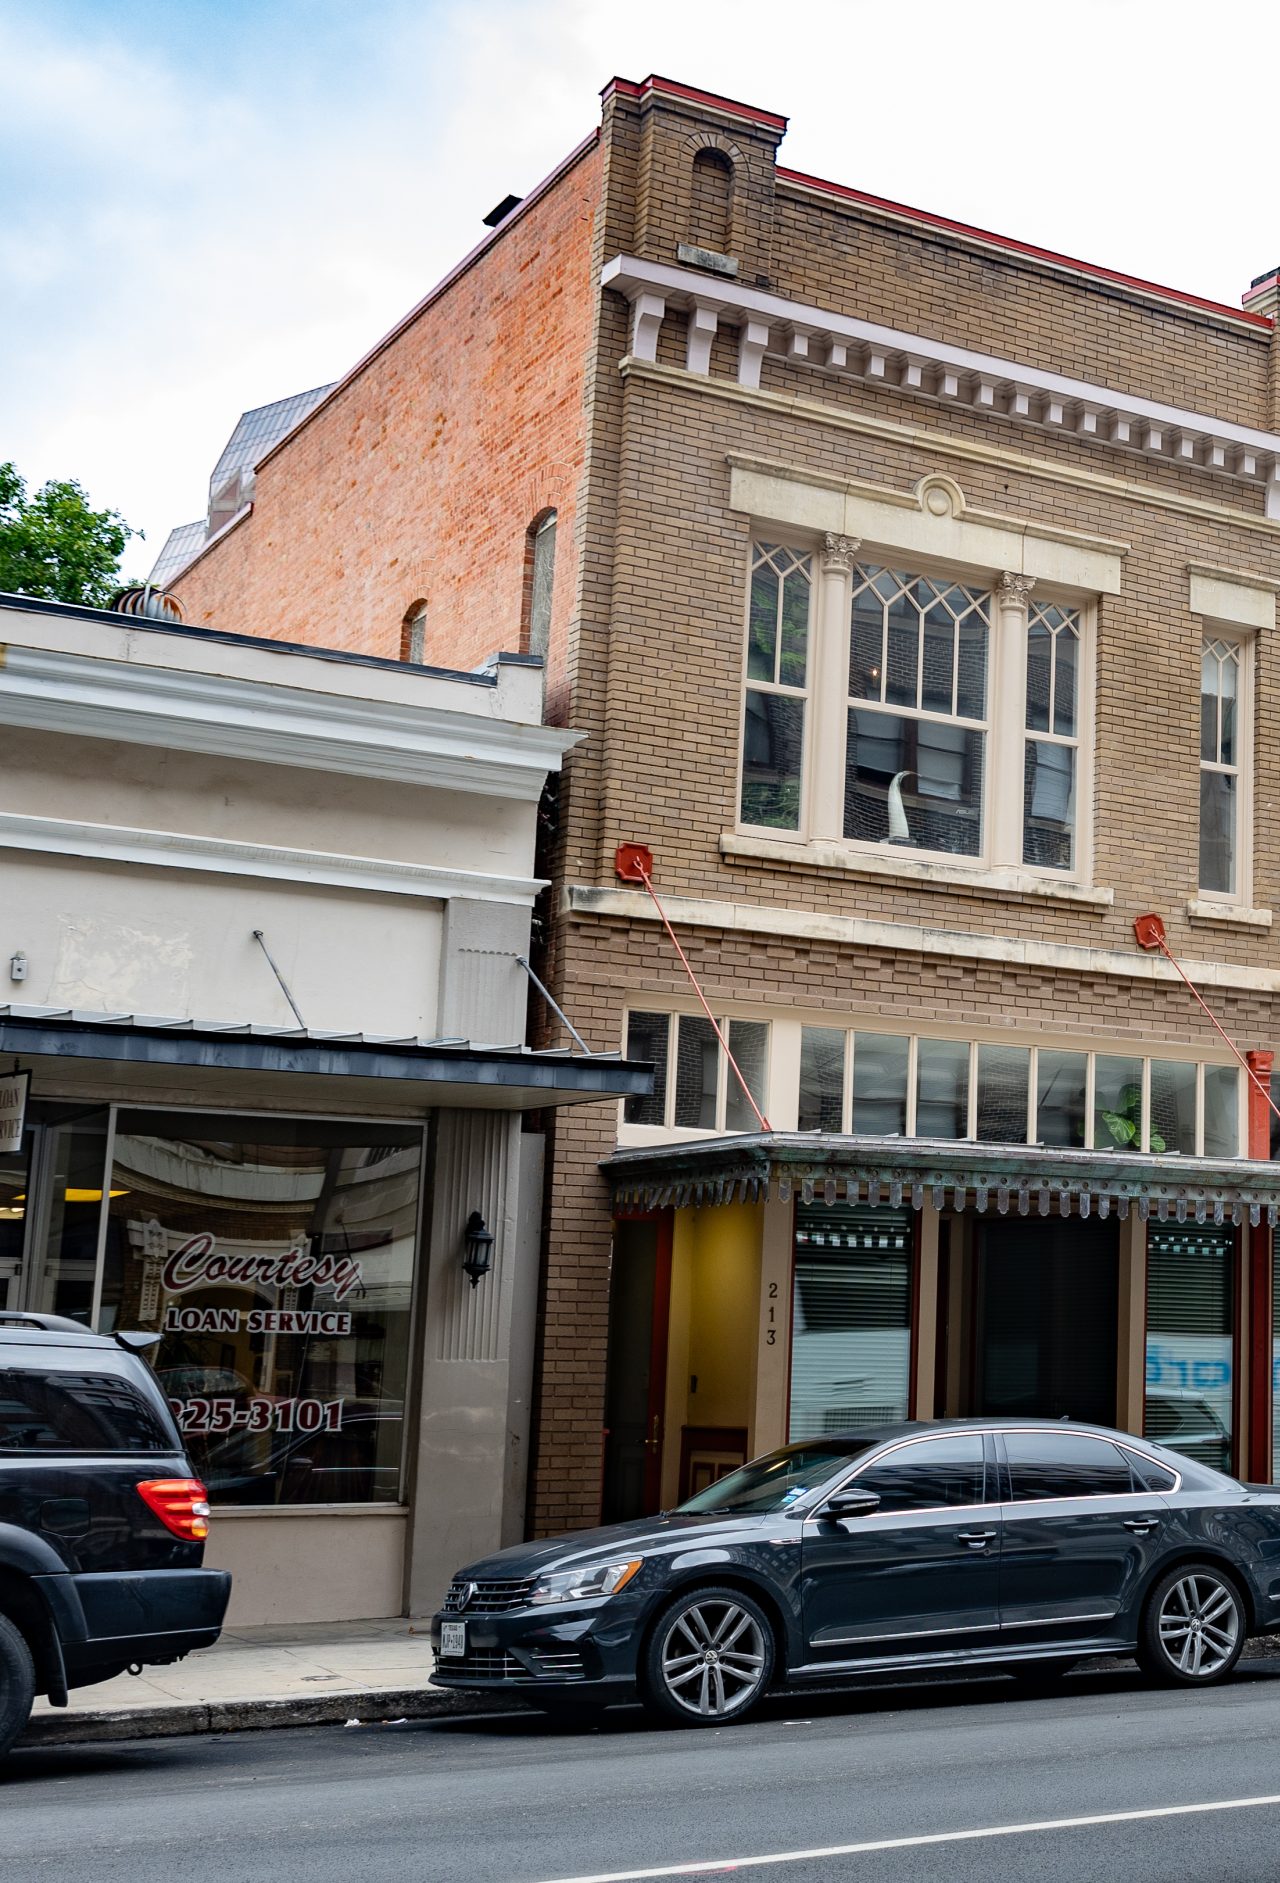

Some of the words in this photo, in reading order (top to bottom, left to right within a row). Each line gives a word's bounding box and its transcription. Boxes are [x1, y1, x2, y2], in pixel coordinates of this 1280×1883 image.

[161, 1232, 362, 1302] Courtesy
[166, 1307, 240, 1333] LOAN
[247, 1309, 352, 1335] SERVICE
[766, 1283, 778, 1345] 213
